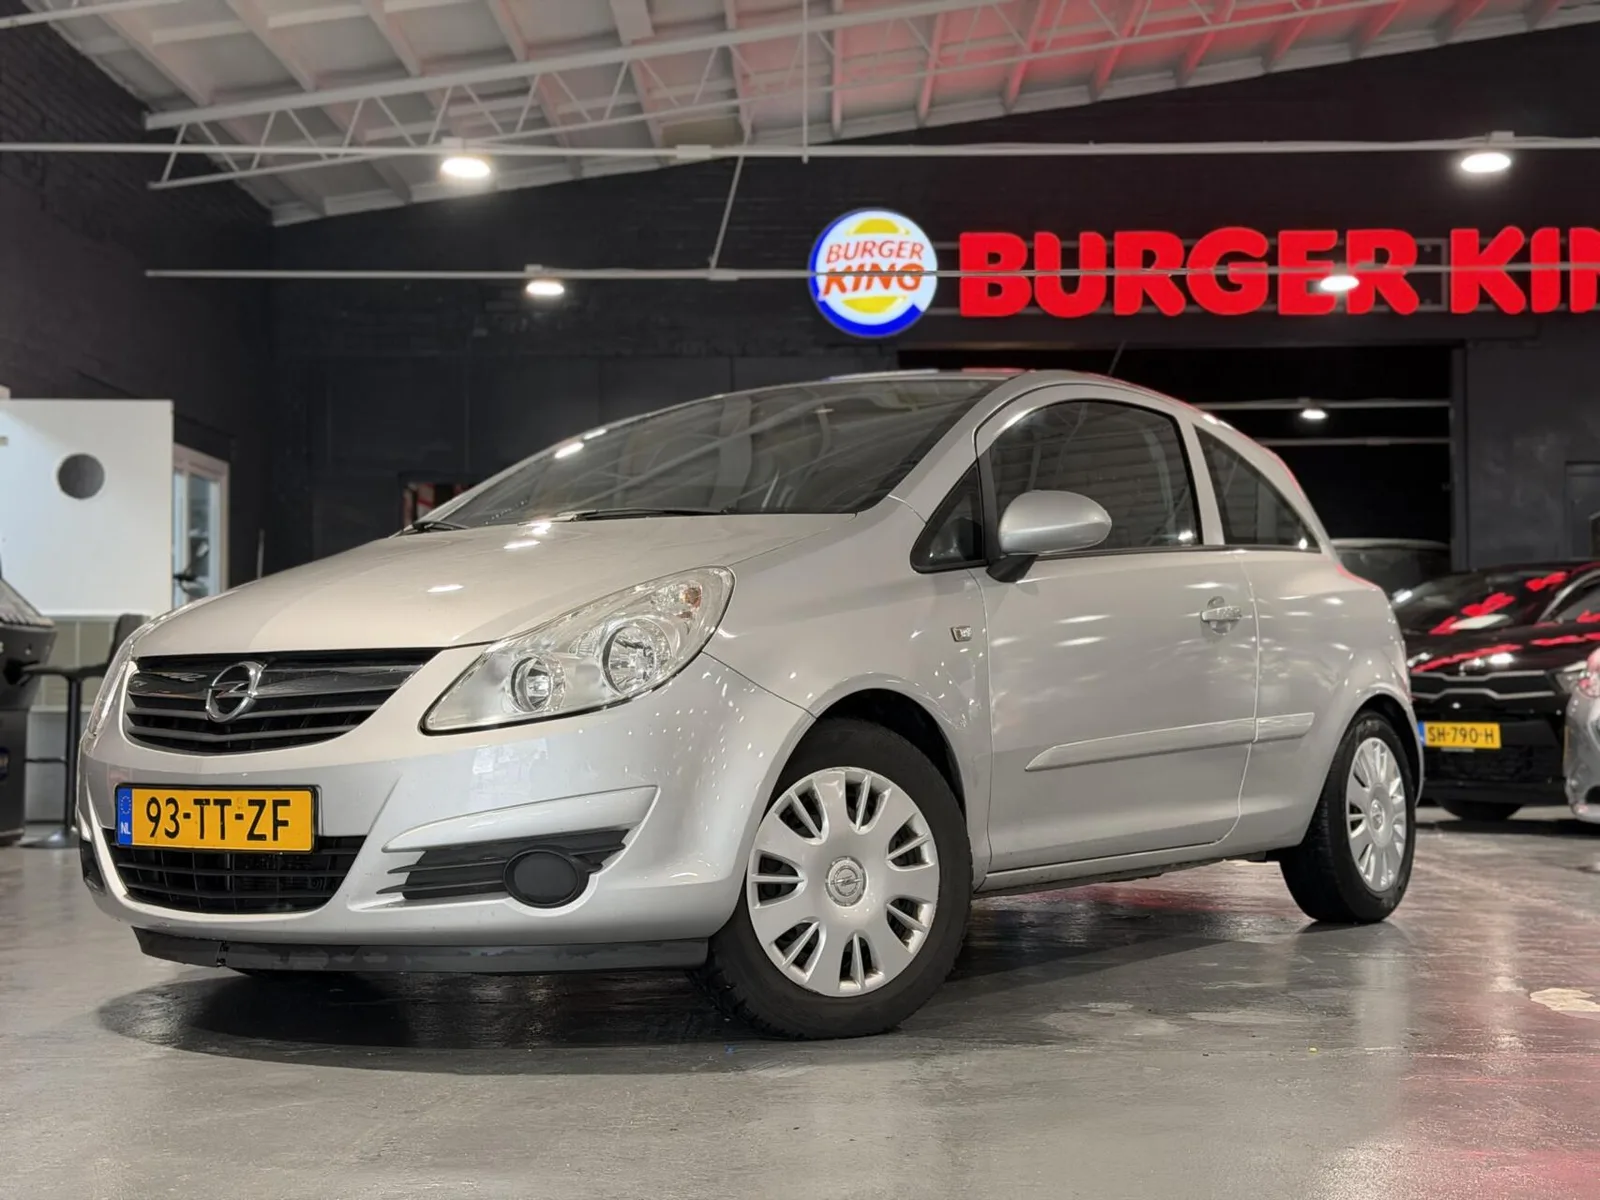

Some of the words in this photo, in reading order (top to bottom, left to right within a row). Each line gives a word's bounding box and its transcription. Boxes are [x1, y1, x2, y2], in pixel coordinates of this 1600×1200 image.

[826, 240, 925, 264] BURGER
[823, 263, 925, 296] KING
[959, 226, 1419, 318] BURGER
[1428, 726, 1495, 744] SH-790-H
[120, 821, 131, 835] NL
[145, 796, 292, 841] 93-TT-ZF
